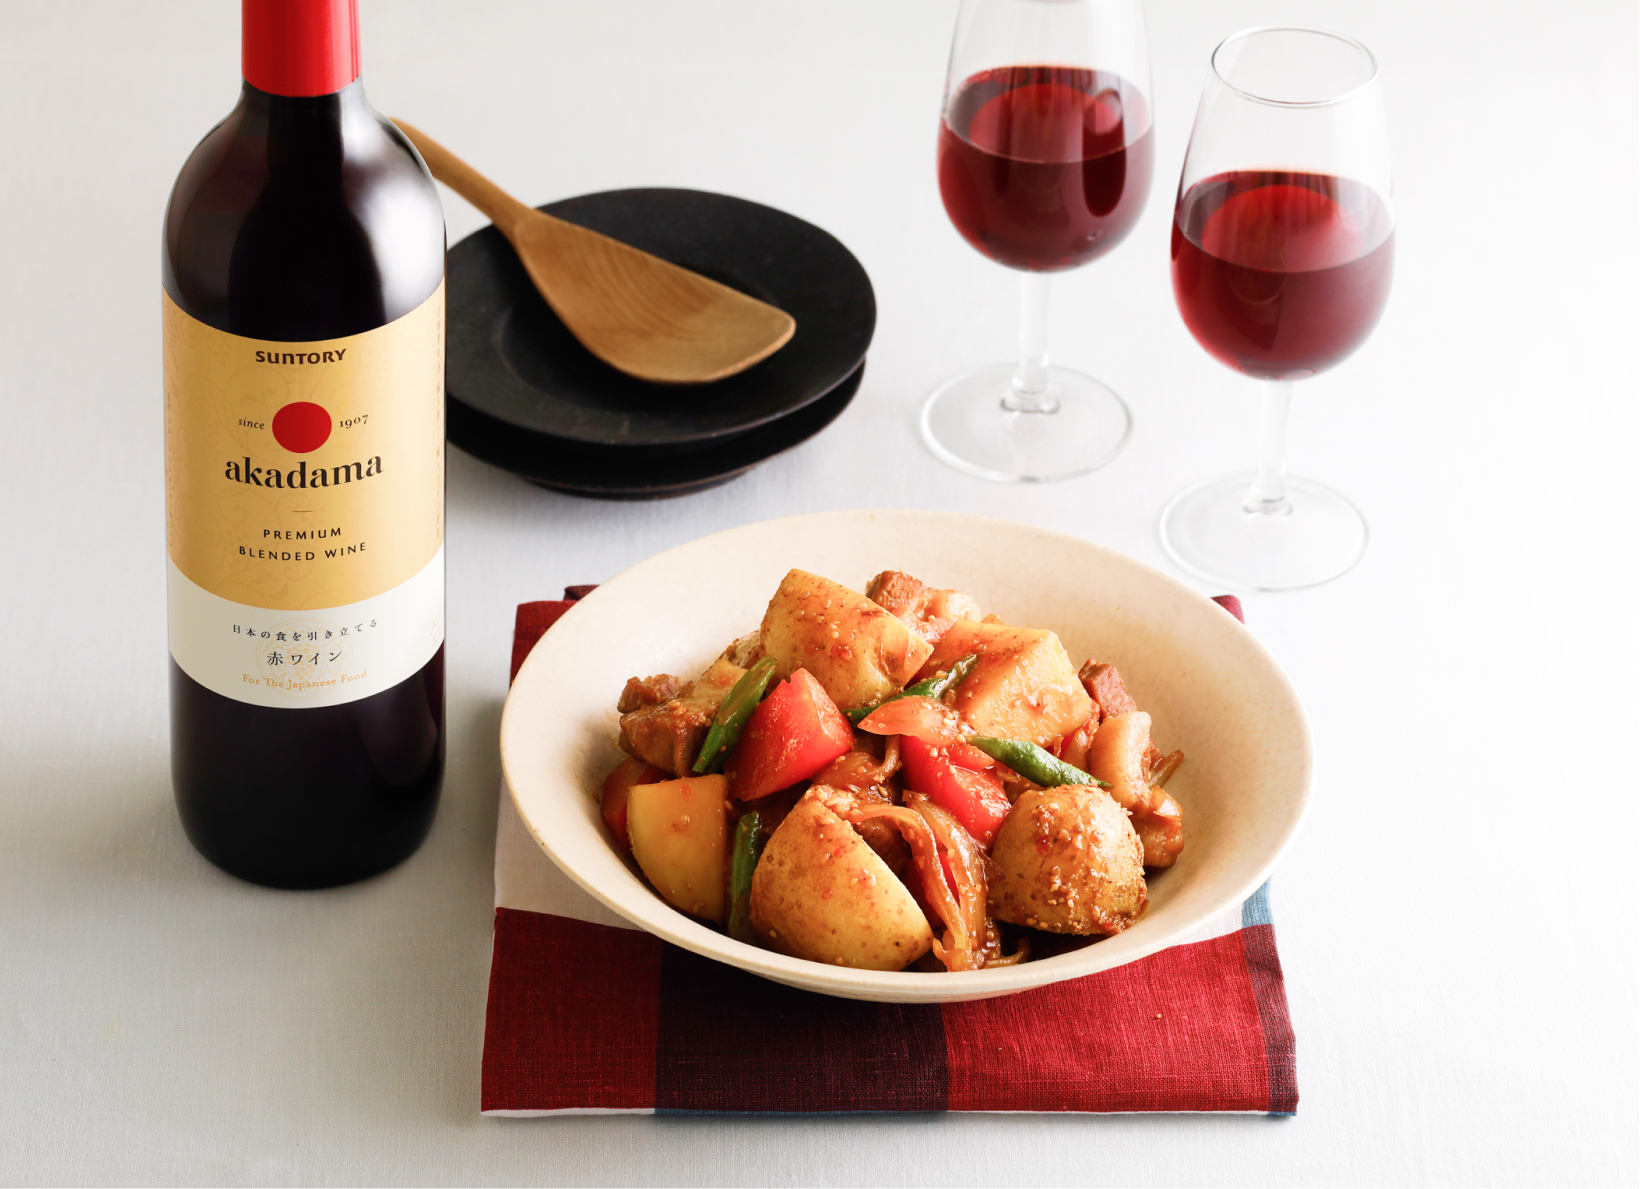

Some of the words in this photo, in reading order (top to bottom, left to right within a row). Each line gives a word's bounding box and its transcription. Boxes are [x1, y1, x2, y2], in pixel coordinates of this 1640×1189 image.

[255, 348, 347, 365] SUNTORY
[237, 416, 265, 430] since
[339, 414, 369, 430] 1907
[224, 456, 384, 489] akadama
[263, 527, 342, 540] PREMIUM
[239, 545, 315, 561] BLENDED
[324, 542, 367, 559] WINE
[232, 618, 378, 642] 日本の食を引き立てる
[266, 651, 343, 666] 赤ワイン
[242, 673, 261, 685] For
[263, 677, 284, 689] The
[286, 679, 337, 691] Japanese
[340, 669, 367, 684] Food
